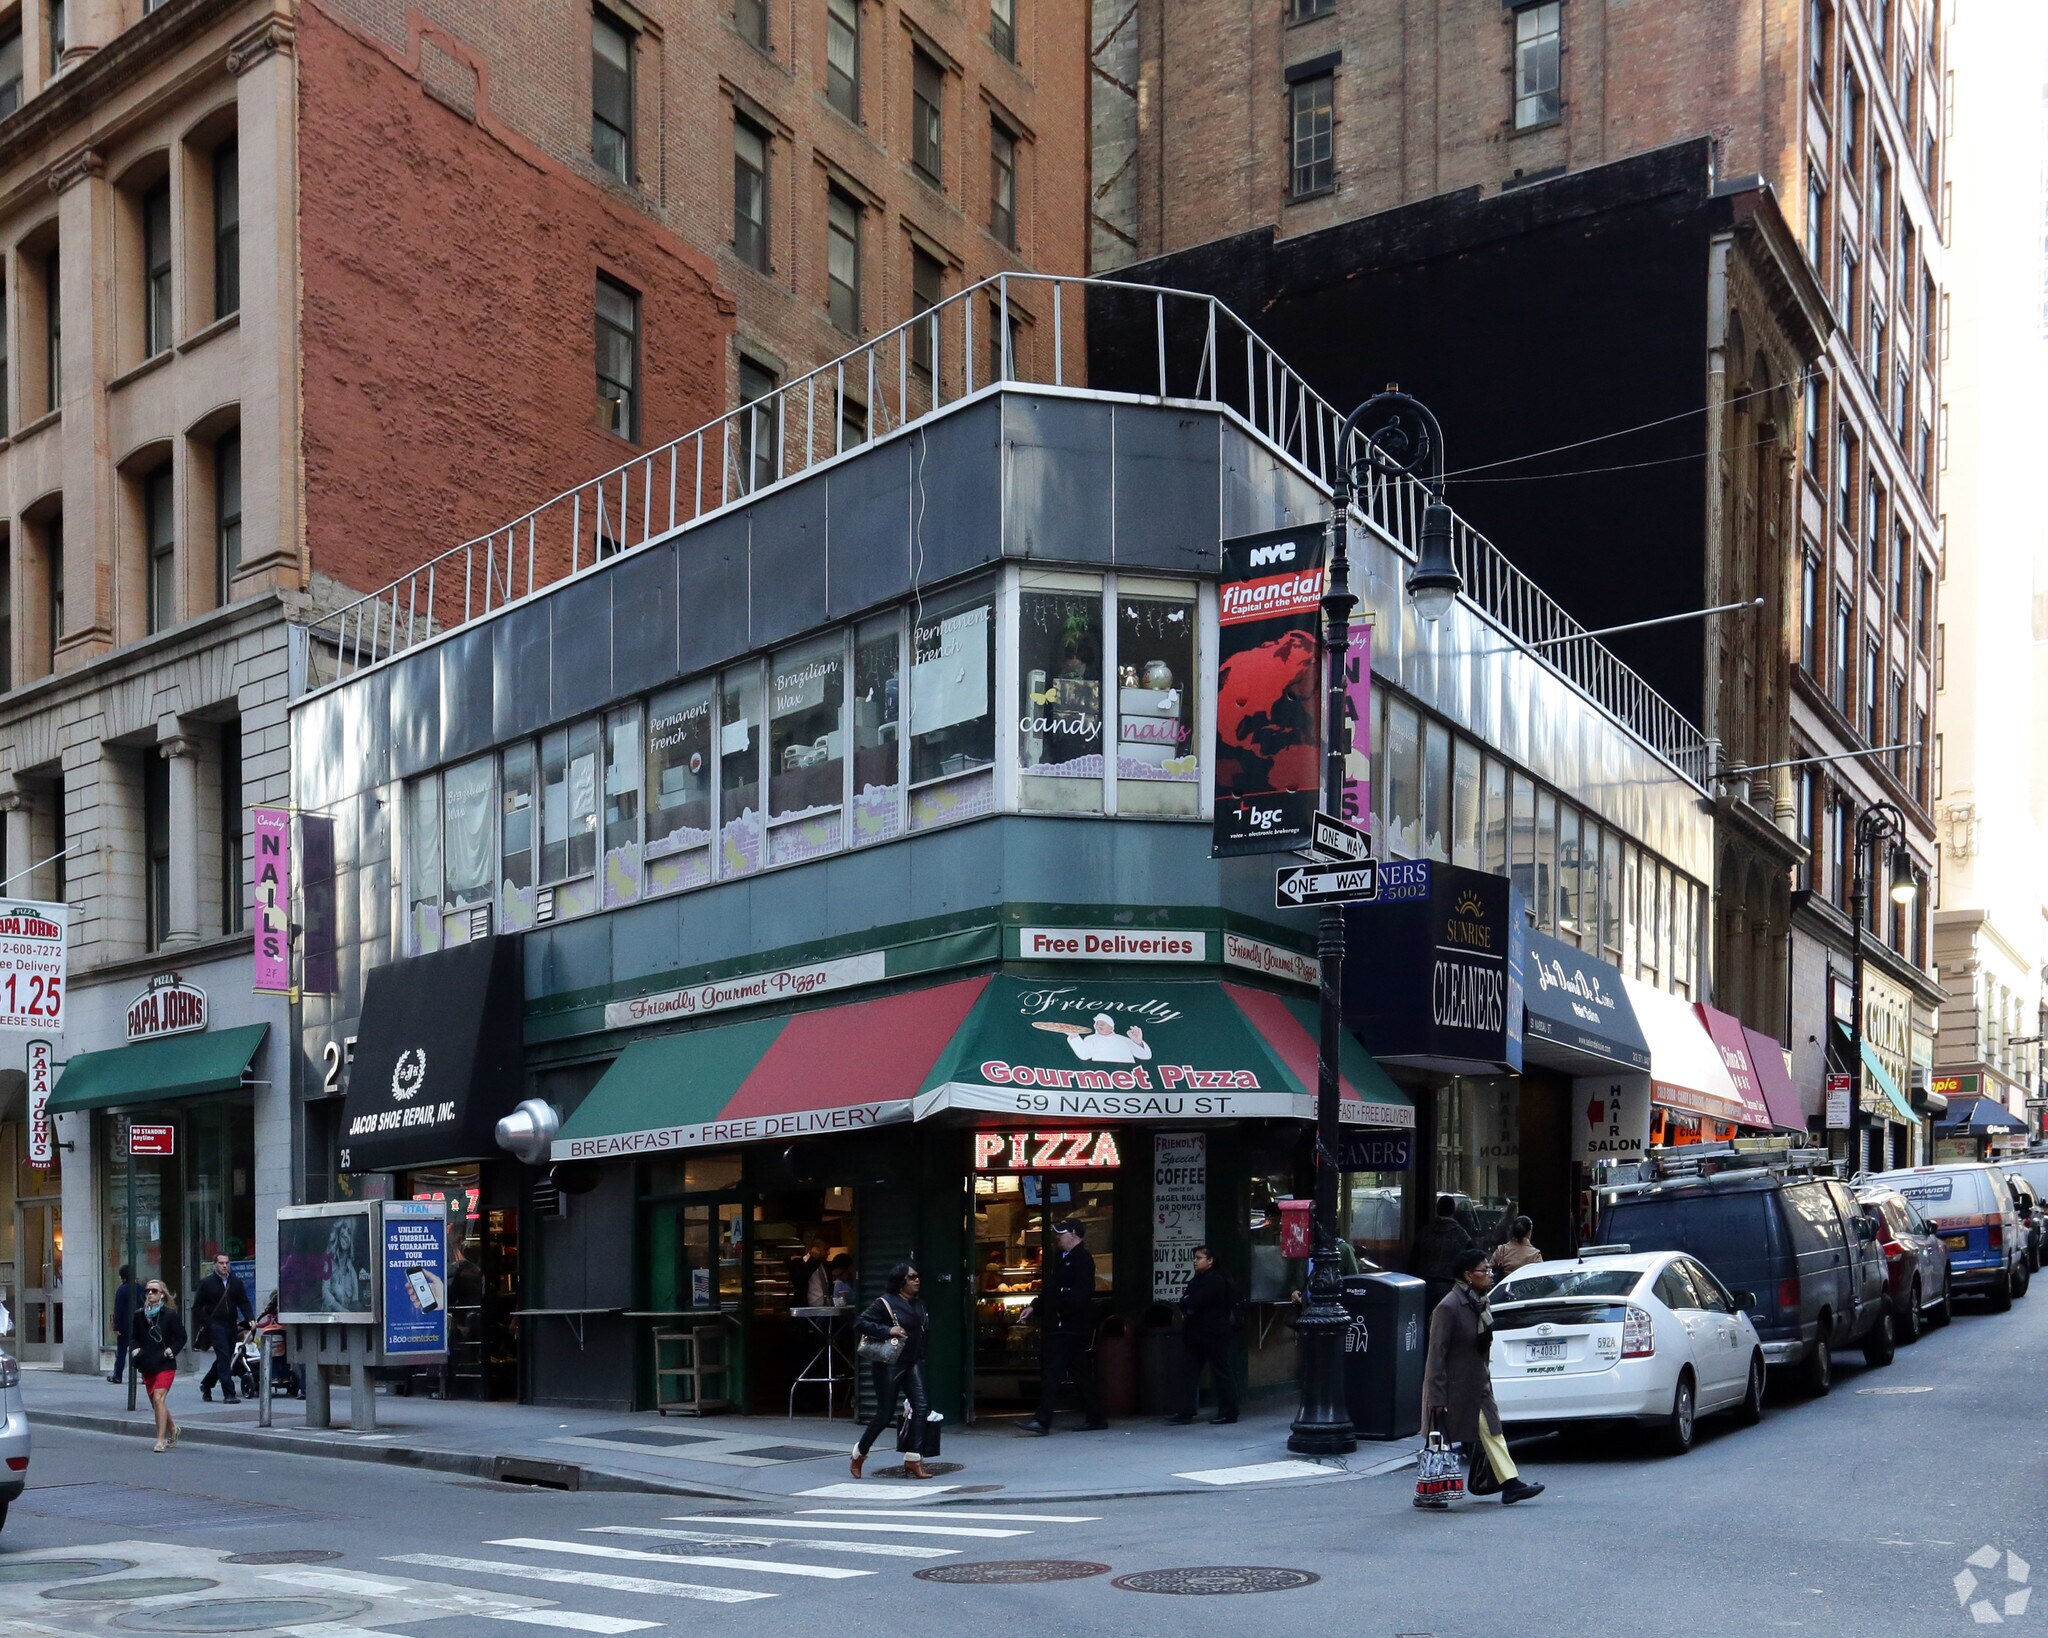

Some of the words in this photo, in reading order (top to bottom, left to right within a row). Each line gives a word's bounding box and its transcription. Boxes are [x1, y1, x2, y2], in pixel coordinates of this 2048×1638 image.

[1250, 542, 1296, 567] NYC
[1222, 572, 1322, 614] financial
[1231, 601, 1262, 615] Capital
[1263, 600, 1274, 610] of
[1276, 598, 1290, 609] the
[1292, 592, 1321, 606] World
[915, 604, 992, 645] Permanent
[915, 638, 964, 666] French
[775, 660, 839, 691] Brazilian
[776, 692, 805, 712] Wax
[650, 700, 710, 733] Permanent
[1019, 711, 1103, 742] candy
[650, 728, 687, 754] French
[1122, 716, 1192, 744] nails
[257, 814, 285, 831] Candy
[1250, 806, 1283, 831] bgc
[1321, 827, 1340, 847] ONE
[1346, 838, 1364, 860] WAY
[1287, 876, 1318, 895] ONE
[1336, 872, 1367, 889] WAY
[261, 834, 280, 958] NAILS
[15, 908, 36, 917] PIZZA
[1034, 934, 1081, 953] Free
[1085, 934, 1193, 954] Deliveries
[1447, 918, 1491, 949] SUNRISE
[16, 959, 61, 976] Delivery
[1227, 936, 1262, 968] Friendly
[1263, 947, 1294, 974] Gourmet
[1295, 957, 1317, 982] Pizza
[153, 975, 174, 987] PIZZA
[266, 968, 278, 979] 2F
[0, 972, 61, 1017] 1.25
[628, 993, 695, 1019] Friendly
[701, 979, 768, 1009] Gourmet
[770, 971, 827, 994] Pizza
[1017, 986, 1183, 1024] Friendly
[1433, 960, 1503, 1033] CLEANERS
[30, 1017, 61, 1028] SLICE
[128, 995, 160, 1037] PAPA
[32, 1047, 47, 1092] PAPA
[981, 1060, 1153, 1090] Gourmet
[1157, 1065, 1261, 1090] Pizza
[1015, 1094, 1049, 1111] 59
[1060, 1095, 1183, 1114] NASSAU
[1194, 1097, 1236, 1114] ST.
[1361, 1105, 1380, 1122] FREE
[1381, 1107, 1413, 1124] DELIVERY
[1609, 1084, 1621, 1136] HAIR
[32, 1098, 48, 1156] JOHNS
[350, 1114, 378, 1136] JACOB
[377, 1110, 401, 1132] SHOE
[402, 1105, 434, 1128] REPAIR,
[437, 1101, 456, 1122] INC.
[133, 1134, 154, 1142] Anytime
[571, 1129, 683, 1157] BREAKFAST
[702, 1120, 757, 1142] FREE
[765, 1106, 882, 1135] DELIVERY
[1156, 1134, 1205, 1152] FRIENDLY'S
[975, 1131, 1120, 1168] PIZZA
[1587, 1138, 1642, 1152] SALON
[340, 1149, 350, 1168] 25
[1161, 1152, 1201, 1166] Special
[1156, 1167, 1204, 1185] COFFEE
[1182, 1194, 1205, 1202] ROLLS
[1902, 1187, 1950, 1196] CITYWIDE
[401, 1204, 429, 1213] TITAN
[1172, 1203, 1201, 1211] DONUTS
[399, 1234, 437, 1243] UMBRELLA,
[734, 1220, 741, 1236] A
[389, 1260, 438, 1268] SATISFACTION.
[1154, 1249, 1169, 1262] BUY
[1172, 1249, 1176, 1262] 2
[1154, 1270, 1191, 1285] PIZZ
[1597, 1337, 1616, 1348] 592A
